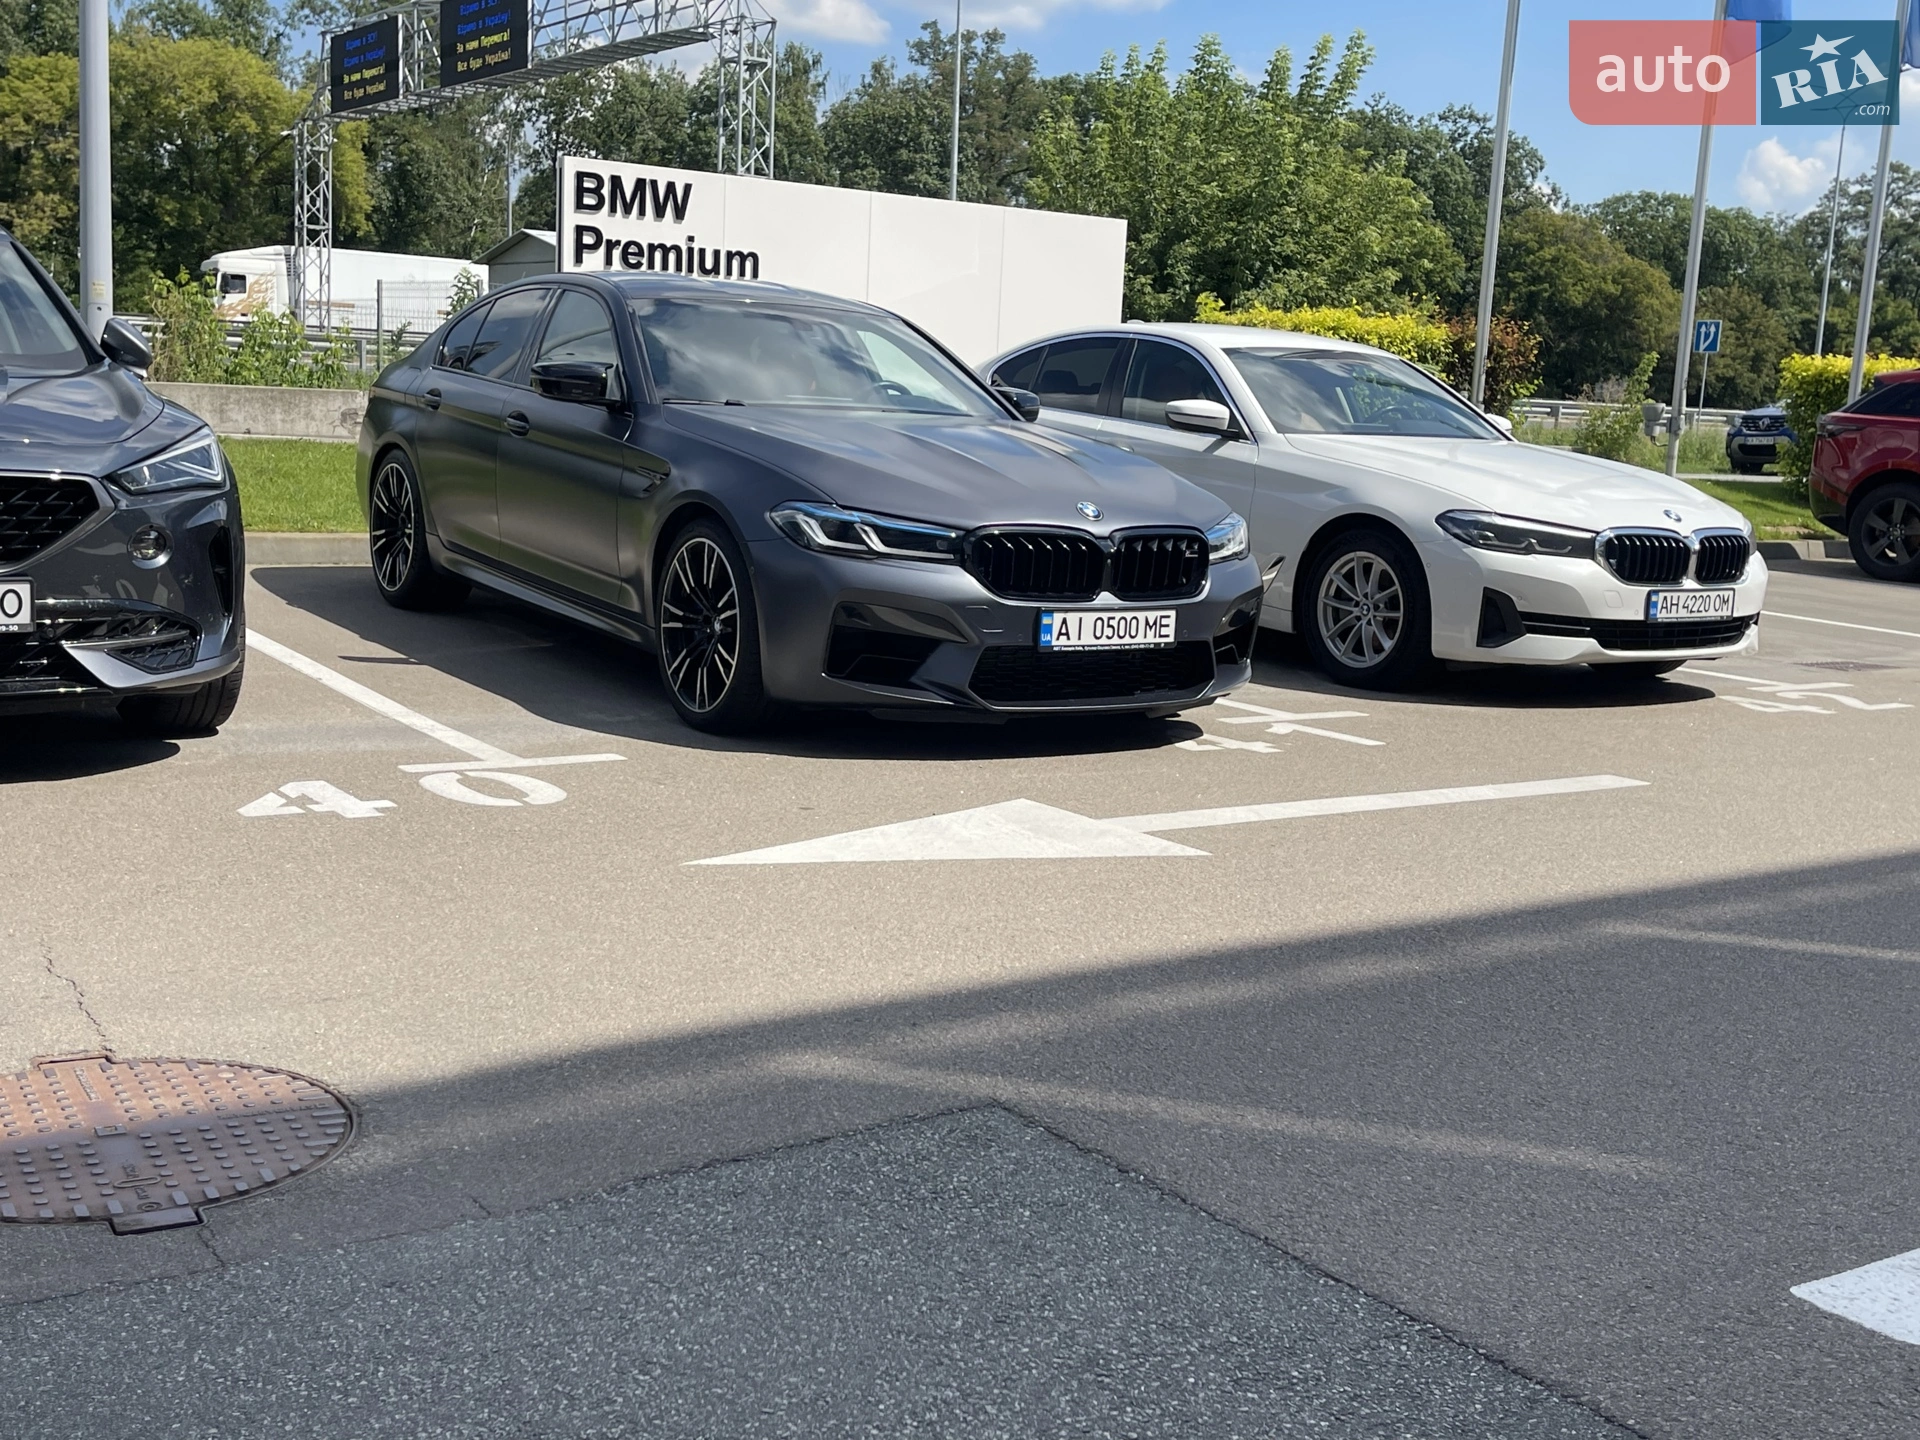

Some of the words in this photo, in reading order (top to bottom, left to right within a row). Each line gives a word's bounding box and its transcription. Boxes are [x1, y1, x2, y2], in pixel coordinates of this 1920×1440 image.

[574, 170, 693, 223] BMW
[574, 224, 759, 279] Premium
[1659, 595, 1680, 614] AH
[1682, 594, 1711, 614] 4220
[1713, 593, 1731, 612] OM
[1041, 633, 1052, 641] UA
[1056, 617, 1083, 641] AI
[1093, 616, 1139, 640] 0500
[1144, 615, 1171, 639] ME
